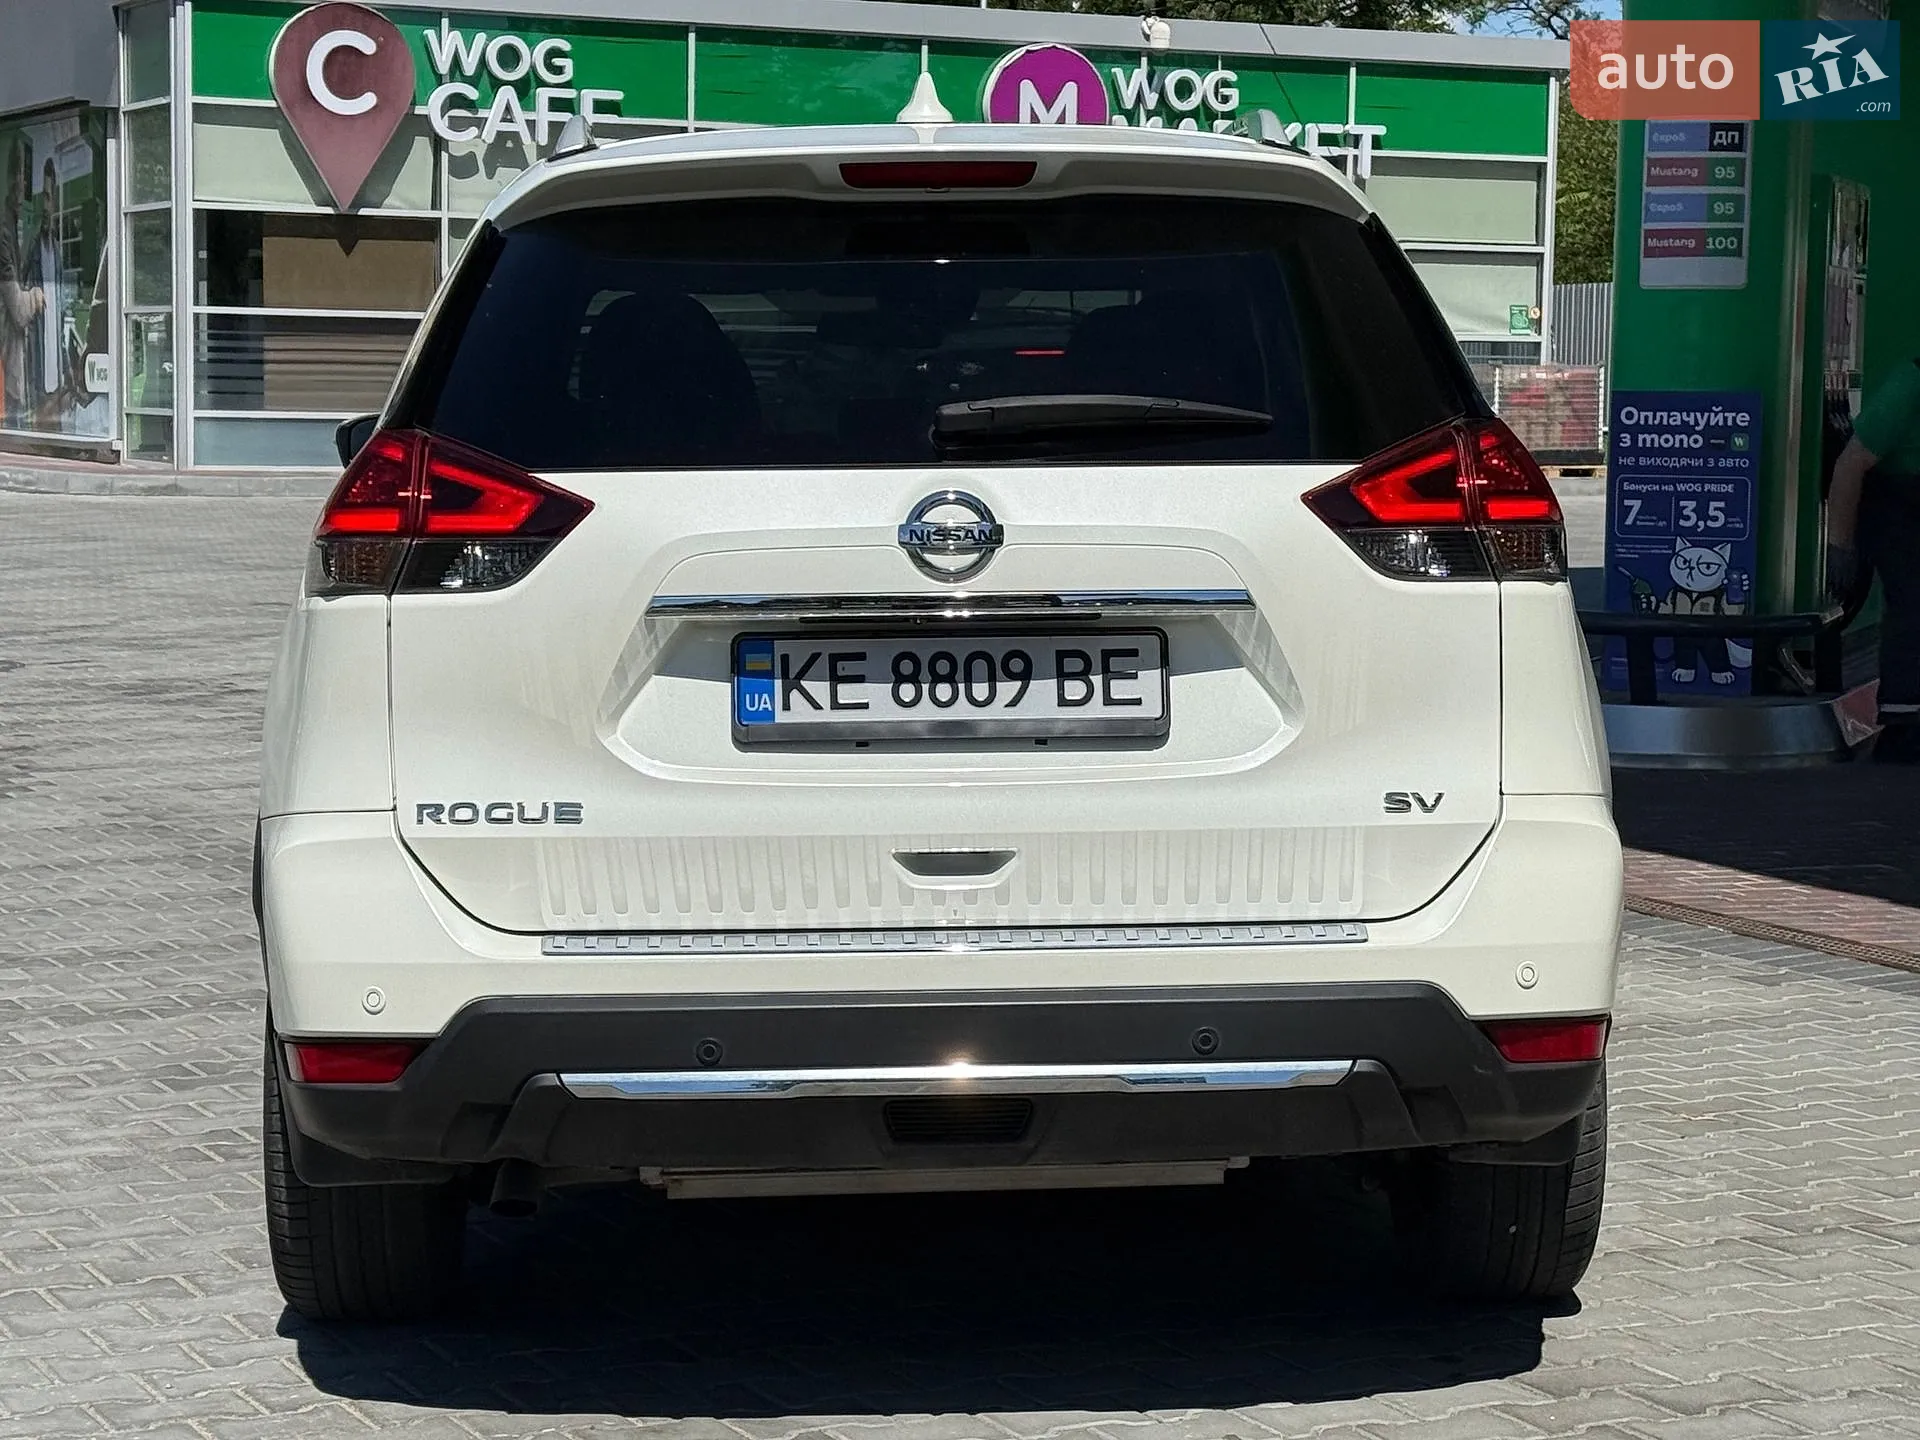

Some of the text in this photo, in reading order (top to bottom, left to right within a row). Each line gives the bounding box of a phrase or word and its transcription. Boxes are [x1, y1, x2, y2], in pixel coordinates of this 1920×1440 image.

[423, 29, 574, 84] WOG
[306, 30, 378, 115] C
[1112, 67, 1240, 112] WOG
[1019, 79, 1078, 125] M
[1713, 131, 1739, 146] ДП
[1650, 166, 1736, 179] Mustang 95
[1713, 201, 1735, 215] 95
[1647, 237, 1738, 249] Mustang 100
[1620, 405, 1751, 431] Оплачуйте
[1619, 433, 1632, 448] з
[1638, 433, 1704, 448] mono
[1618, 456, 1636, 466] не
[1638, 456, 1704, 469] виходячи
[1718, 458, 1750, 468] авто
[1676, 482, 1702, 493] WOG
[1704, 483, 1735, 494] PRIDE
[1623, 499, 1642, 526] 7
[1678, 500, 1726, 533] 3,5
[908, 529, 995, 543] NISSAN
[780, 648, 1144, 711] KE 8809 BE
[745, 694, 773, 713] UA
[1383, 791, 1445, 813] SV
[416, 802, 584, 825] ROGUE
